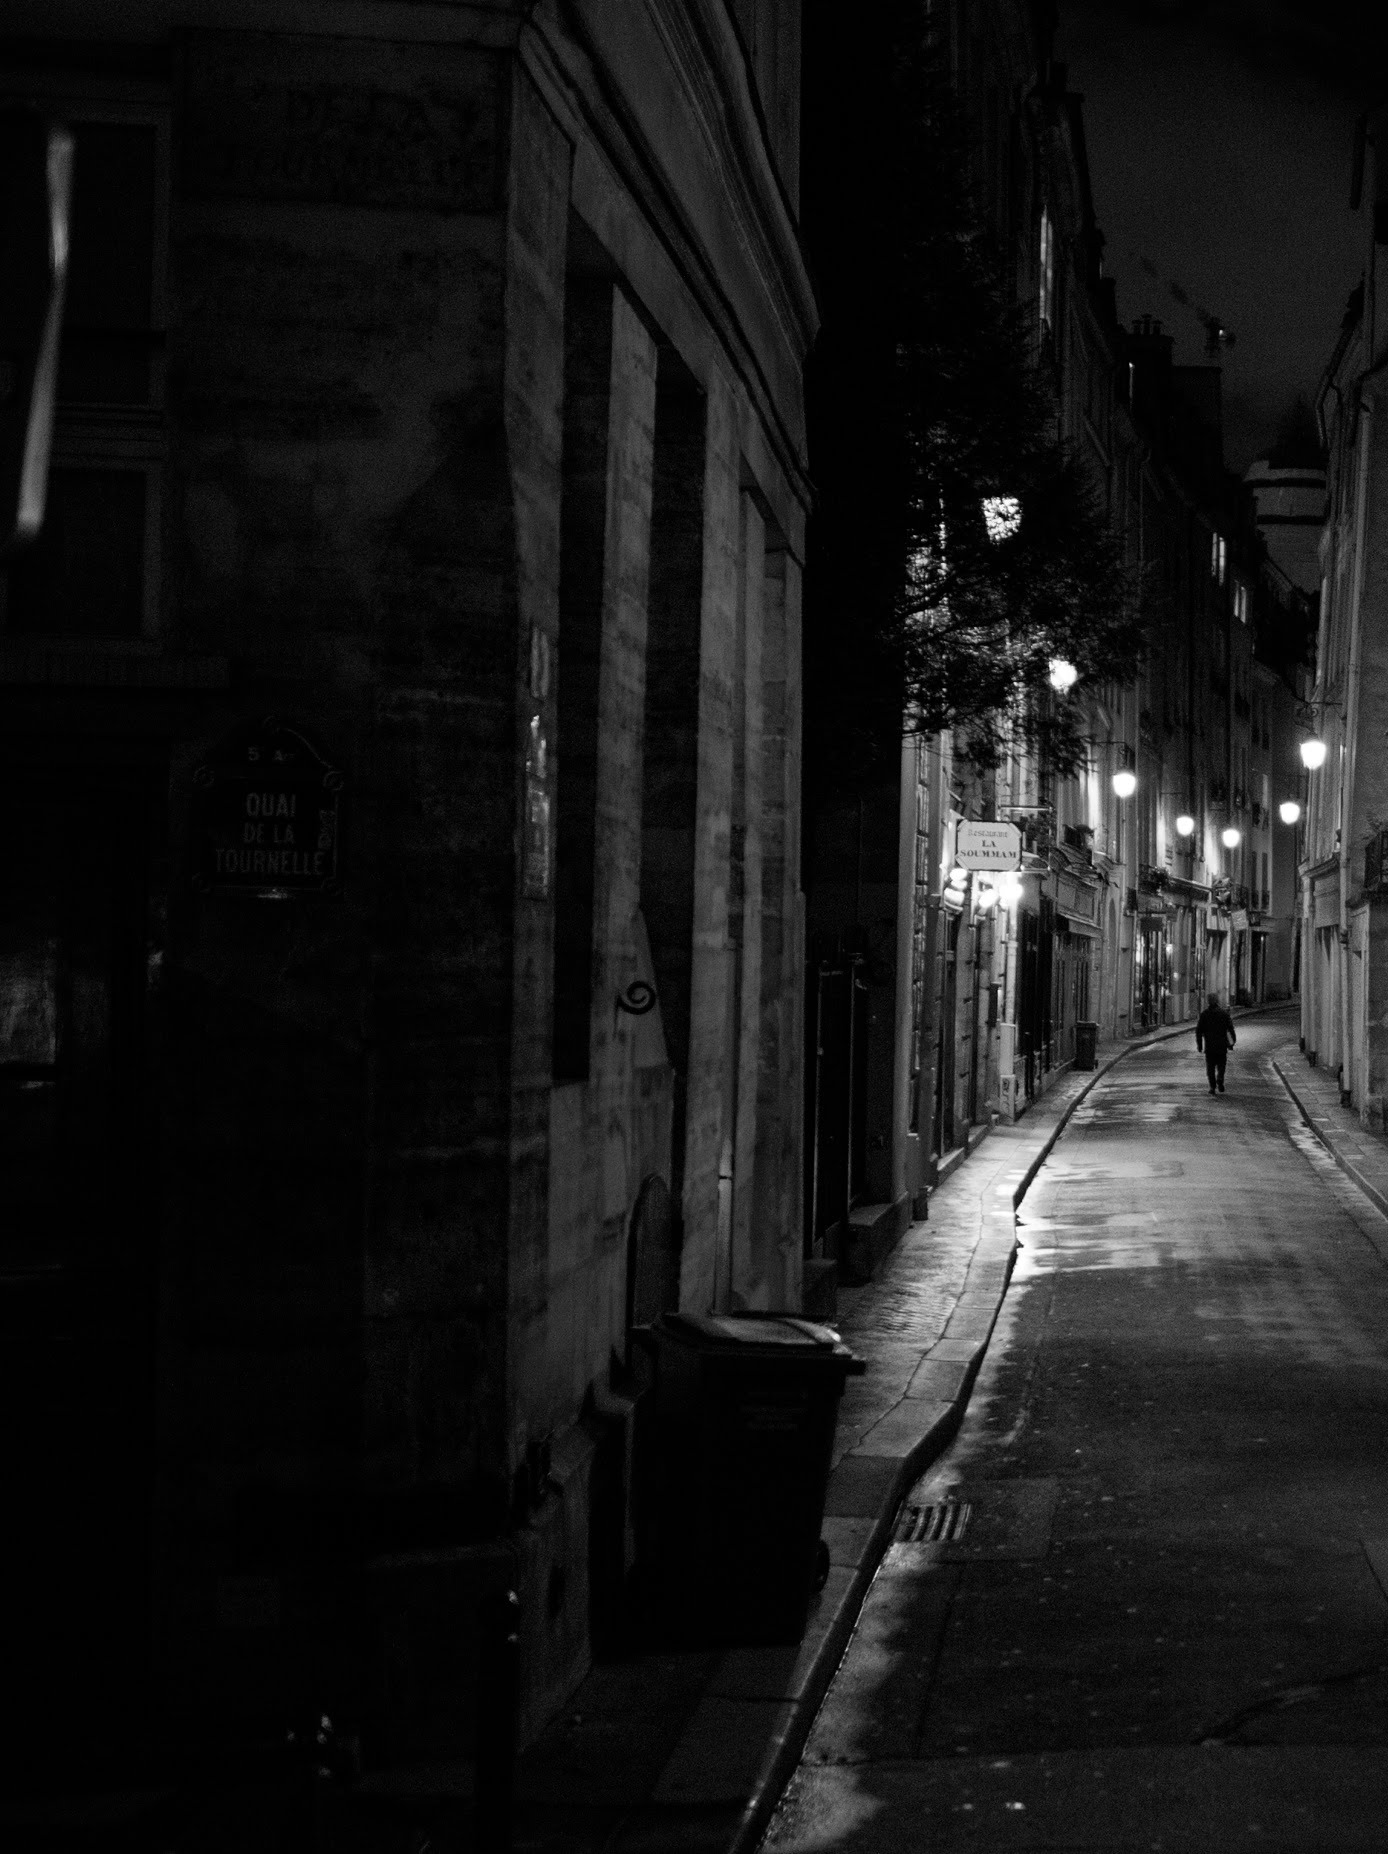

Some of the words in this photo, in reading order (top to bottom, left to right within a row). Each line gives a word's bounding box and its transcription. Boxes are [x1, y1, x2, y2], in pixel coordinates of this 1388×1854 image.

[245, 791, 297, 818] QUAI
[243, 821, 265, 845] DE
[273, 822, 296, 845] LA
[981, 839, 997, 848] LA
[214, 847, 326, 876] TOURNELLE
[959, 849, 1017, 859] SOUMMAM
